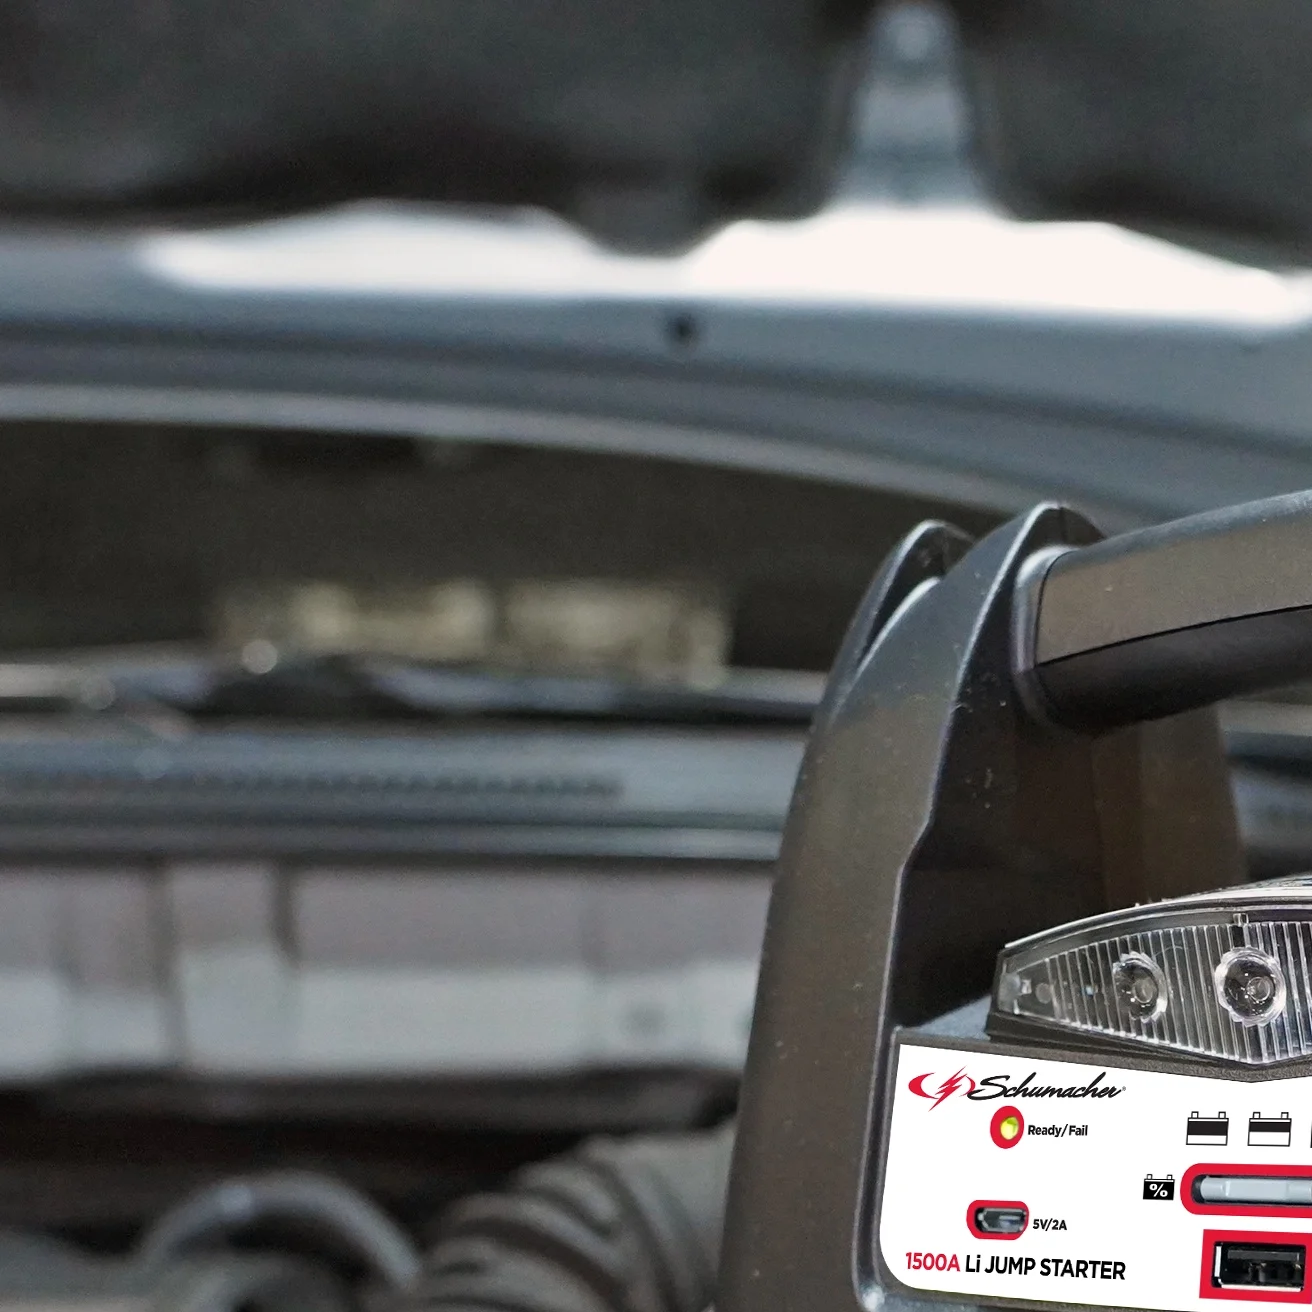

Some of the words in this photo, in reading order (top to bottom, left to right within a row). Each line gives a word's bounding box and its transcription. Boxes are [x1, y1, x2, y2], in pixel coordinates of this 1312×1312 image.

[967, 1072, 1122, 1101] Schumacher
[1027, 1123, 1088, 1138] Ready/Fail
[1032, 1218, 1068, 1232] 5V/2A
[905, 1251, 961, 1273] 1500A
[966, 1253, 982, 1273] Li
[983, 1255, 1037, 1276] JUMP
[1040, 1258, 1127, 1281] STARTER
